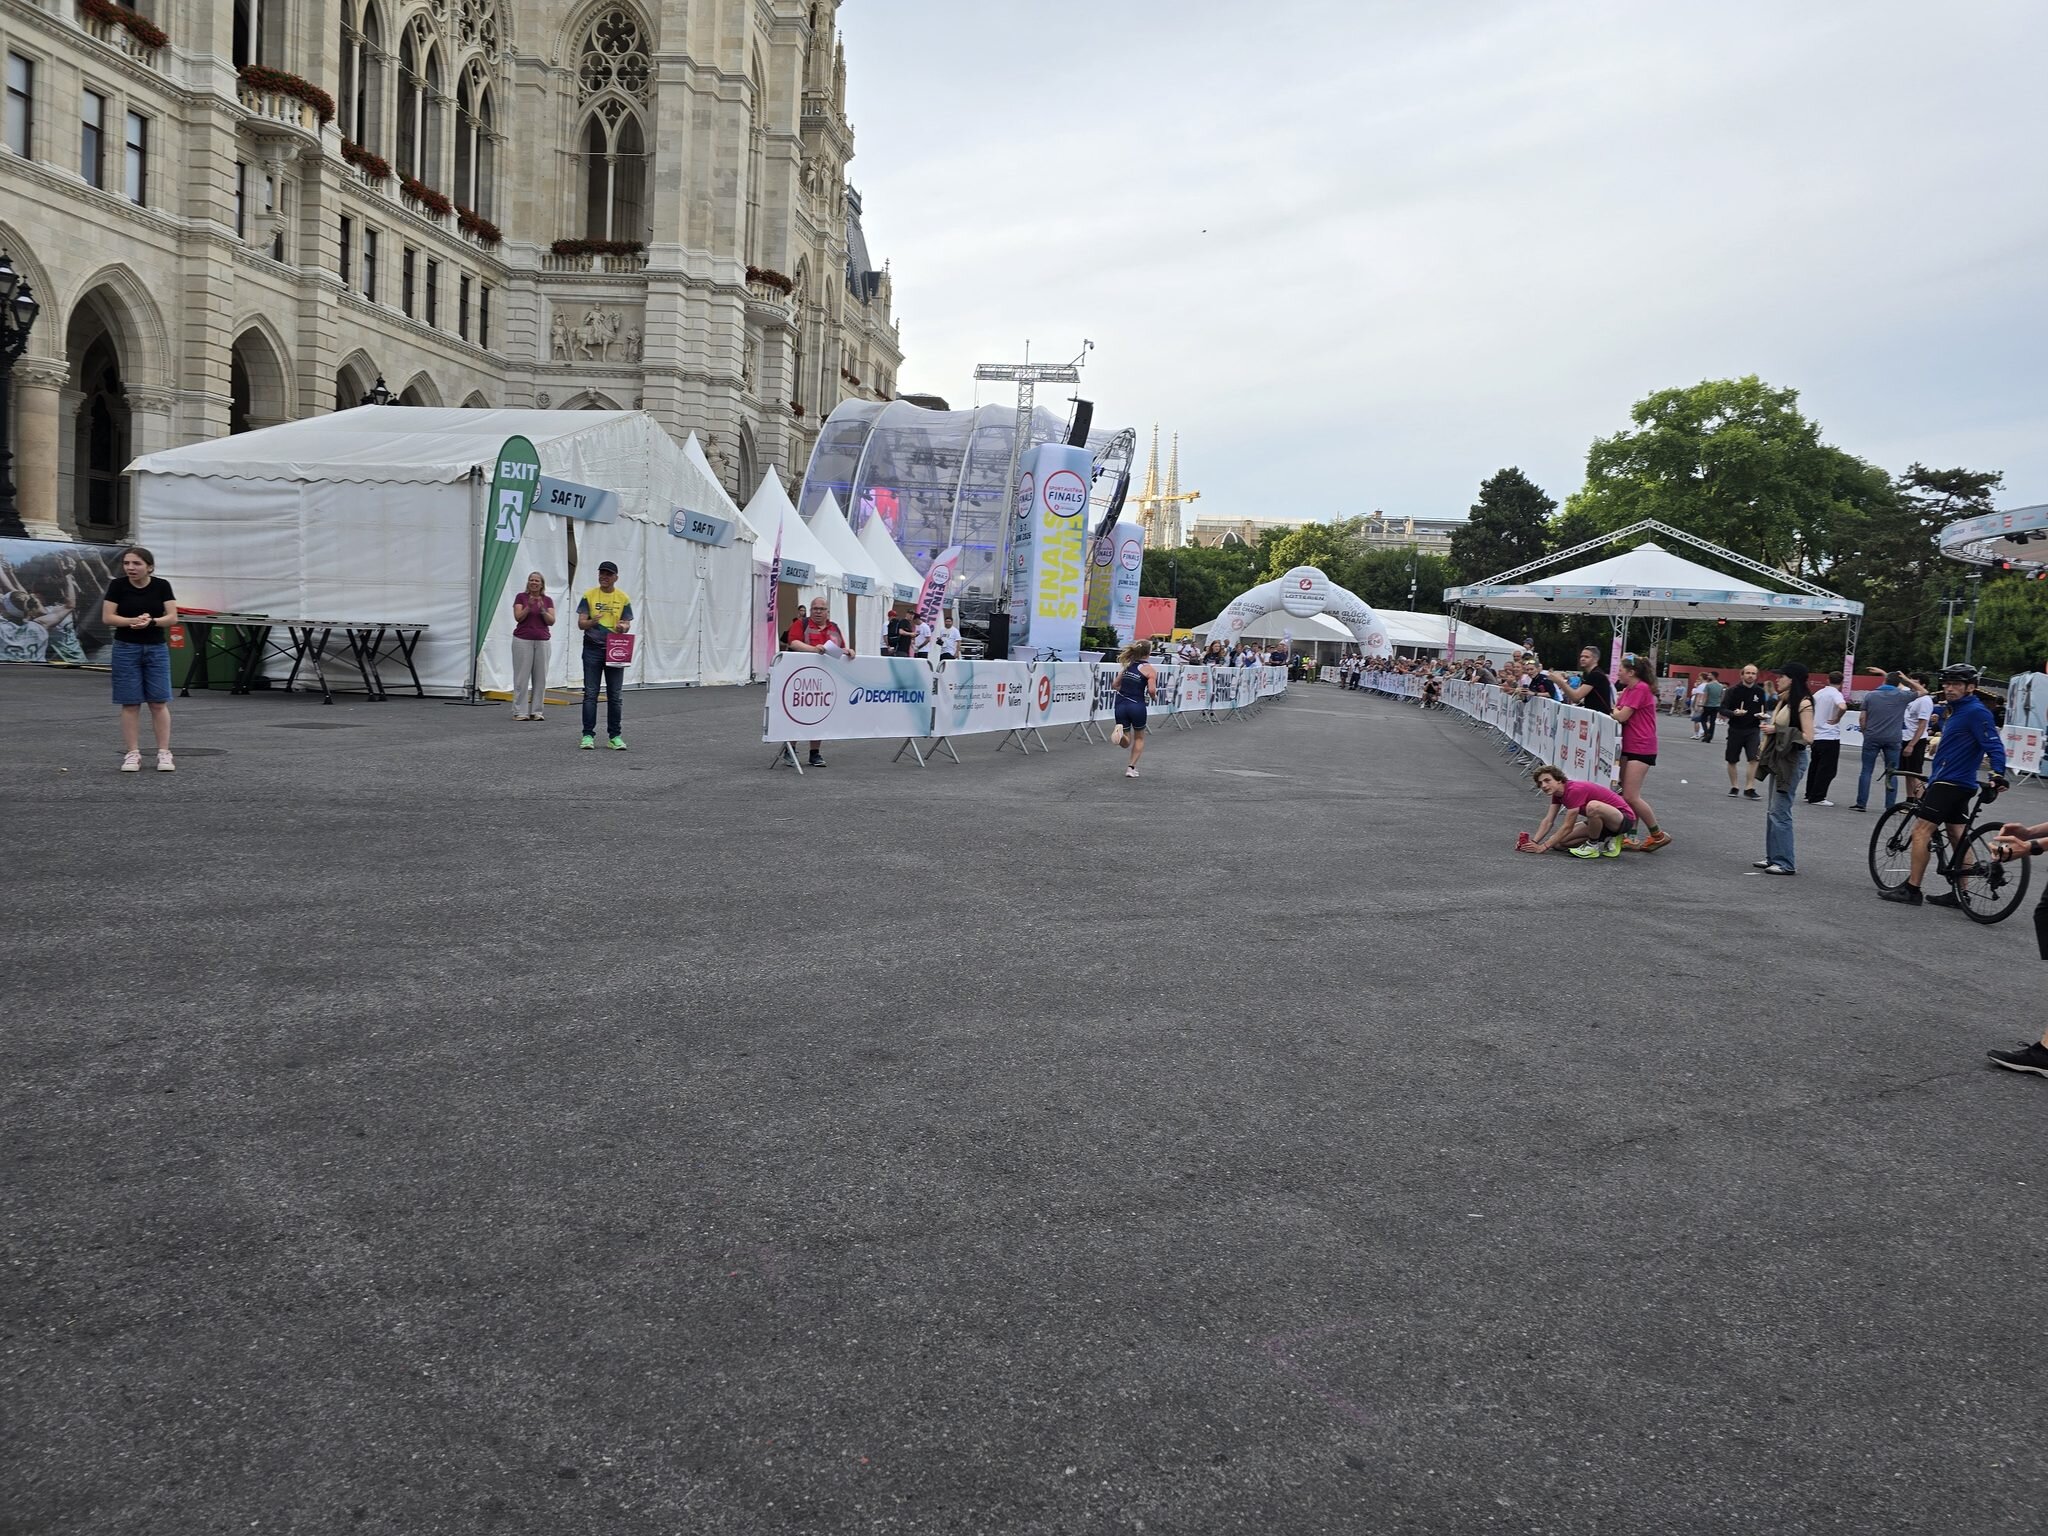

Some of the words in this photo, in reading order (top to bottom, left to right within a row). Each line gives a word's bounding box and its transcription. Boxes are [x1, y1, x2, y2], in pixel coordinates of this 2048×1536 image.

[501, 461, 538, 480] EXIT
[551, 489, 572, 505] SAF
[574, 494, 586, 509] TV
[1048, 491, 1083, 503] FINALS
[692, 520, 706, 534] SAF
[707, 524, 715, 537] TV
[1039, 511, 1063, 618] FINALS
[1058, 514, 1084, 619] FINALS
[786, 566, 809, 579] BACKSTAGE
[793, 677, 822, 692] OMNi
[1009, 683, 1023, 694] Stadt
[865, 689, 925, 704] DECATHLON
[1008, 695, 1021, 706] Wien
[1052, 692, 1086, 703] LOTTERIEN
